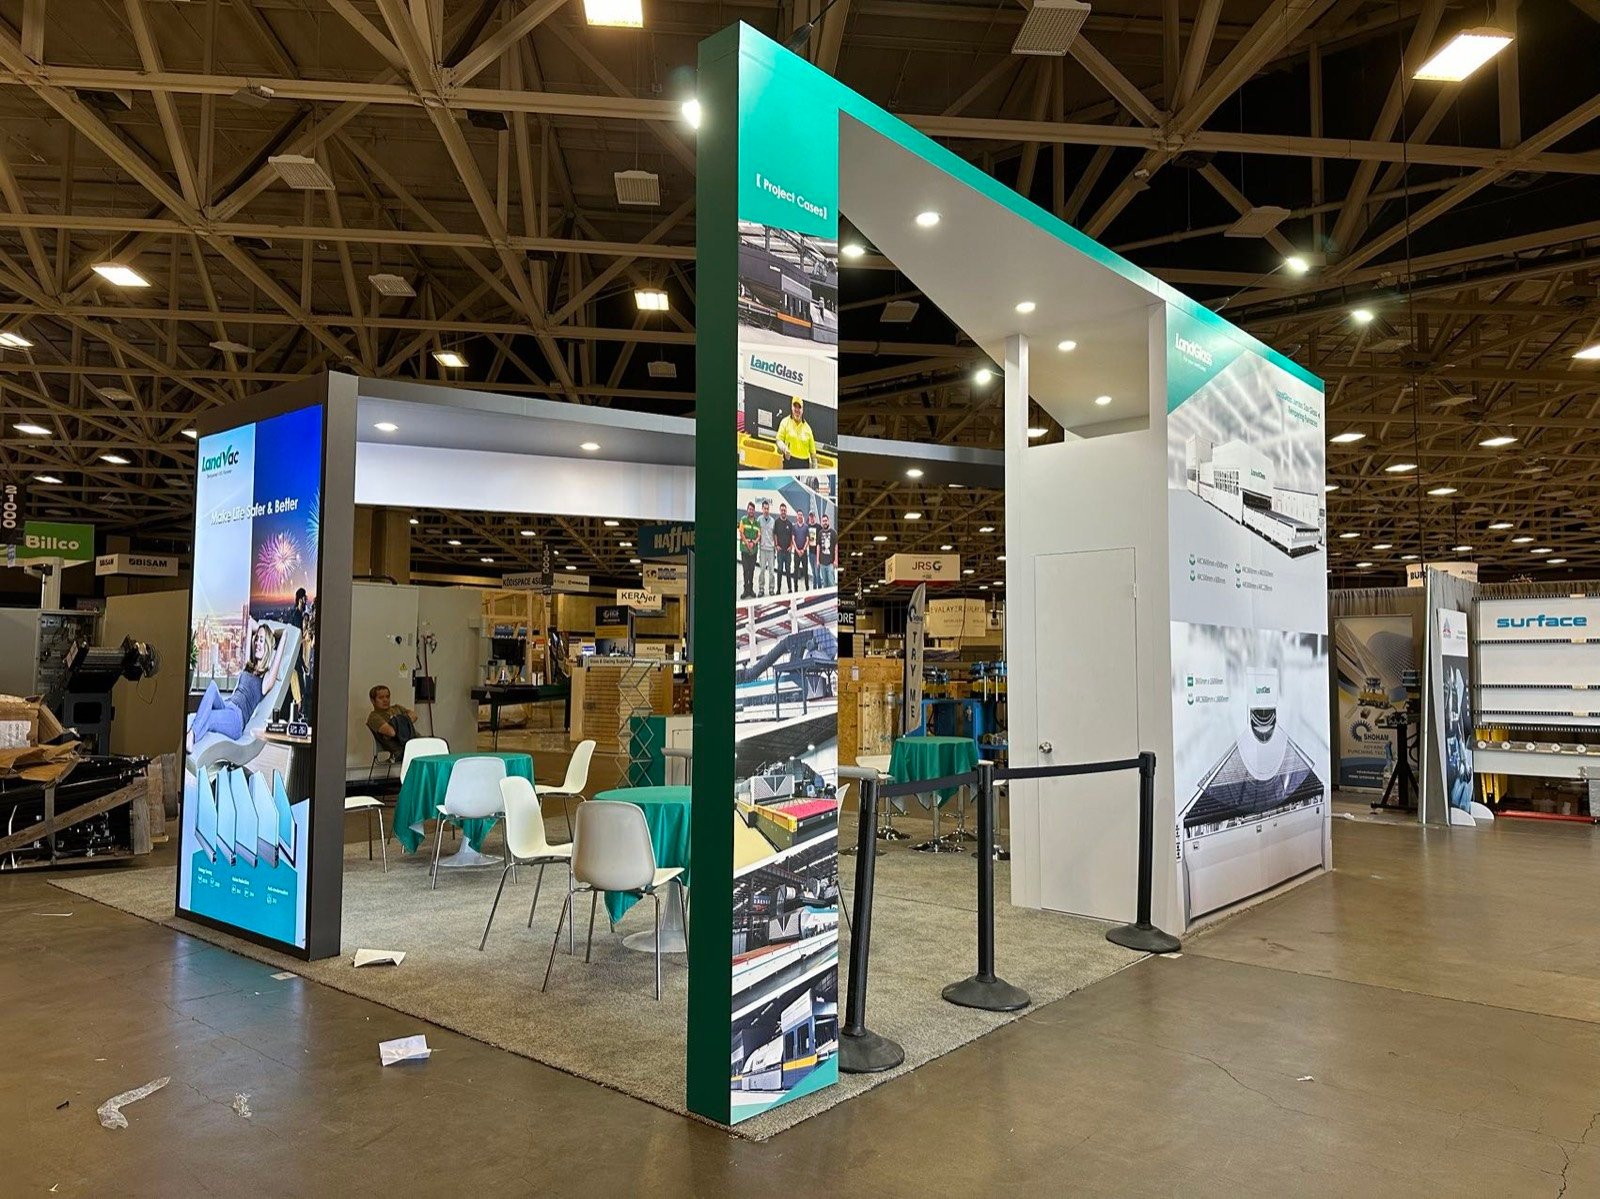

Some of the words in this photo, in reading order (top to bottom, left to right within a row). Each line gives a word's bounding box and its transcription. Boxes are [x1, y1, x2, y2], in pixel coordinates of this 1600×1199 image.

[763, 178, 795, 203] Project
[796, 195, 828, 220] Cases]
[1175, 333, 1212, 367] LandGlass
[750, 354, 804, 384] LandGlass
[201, 444, 239, 472] LandVac
[3, 485, 17, 529] 21000
[211, 509, 231, 525] Make
[232, 506, 245, 521] Life
[246, 502, 266, 519] Safer
[267, 501, 273, 515] &
[274, 496, 299, 513] Better
[25, 535, 79, 550] Billco
[135, 558, 168, 568] BISAM
[621, 592, 656, 602] KERAjet
[1496, 615, 1588, 629] surface
[1363, 733, 1389, 741] SHOHAM
